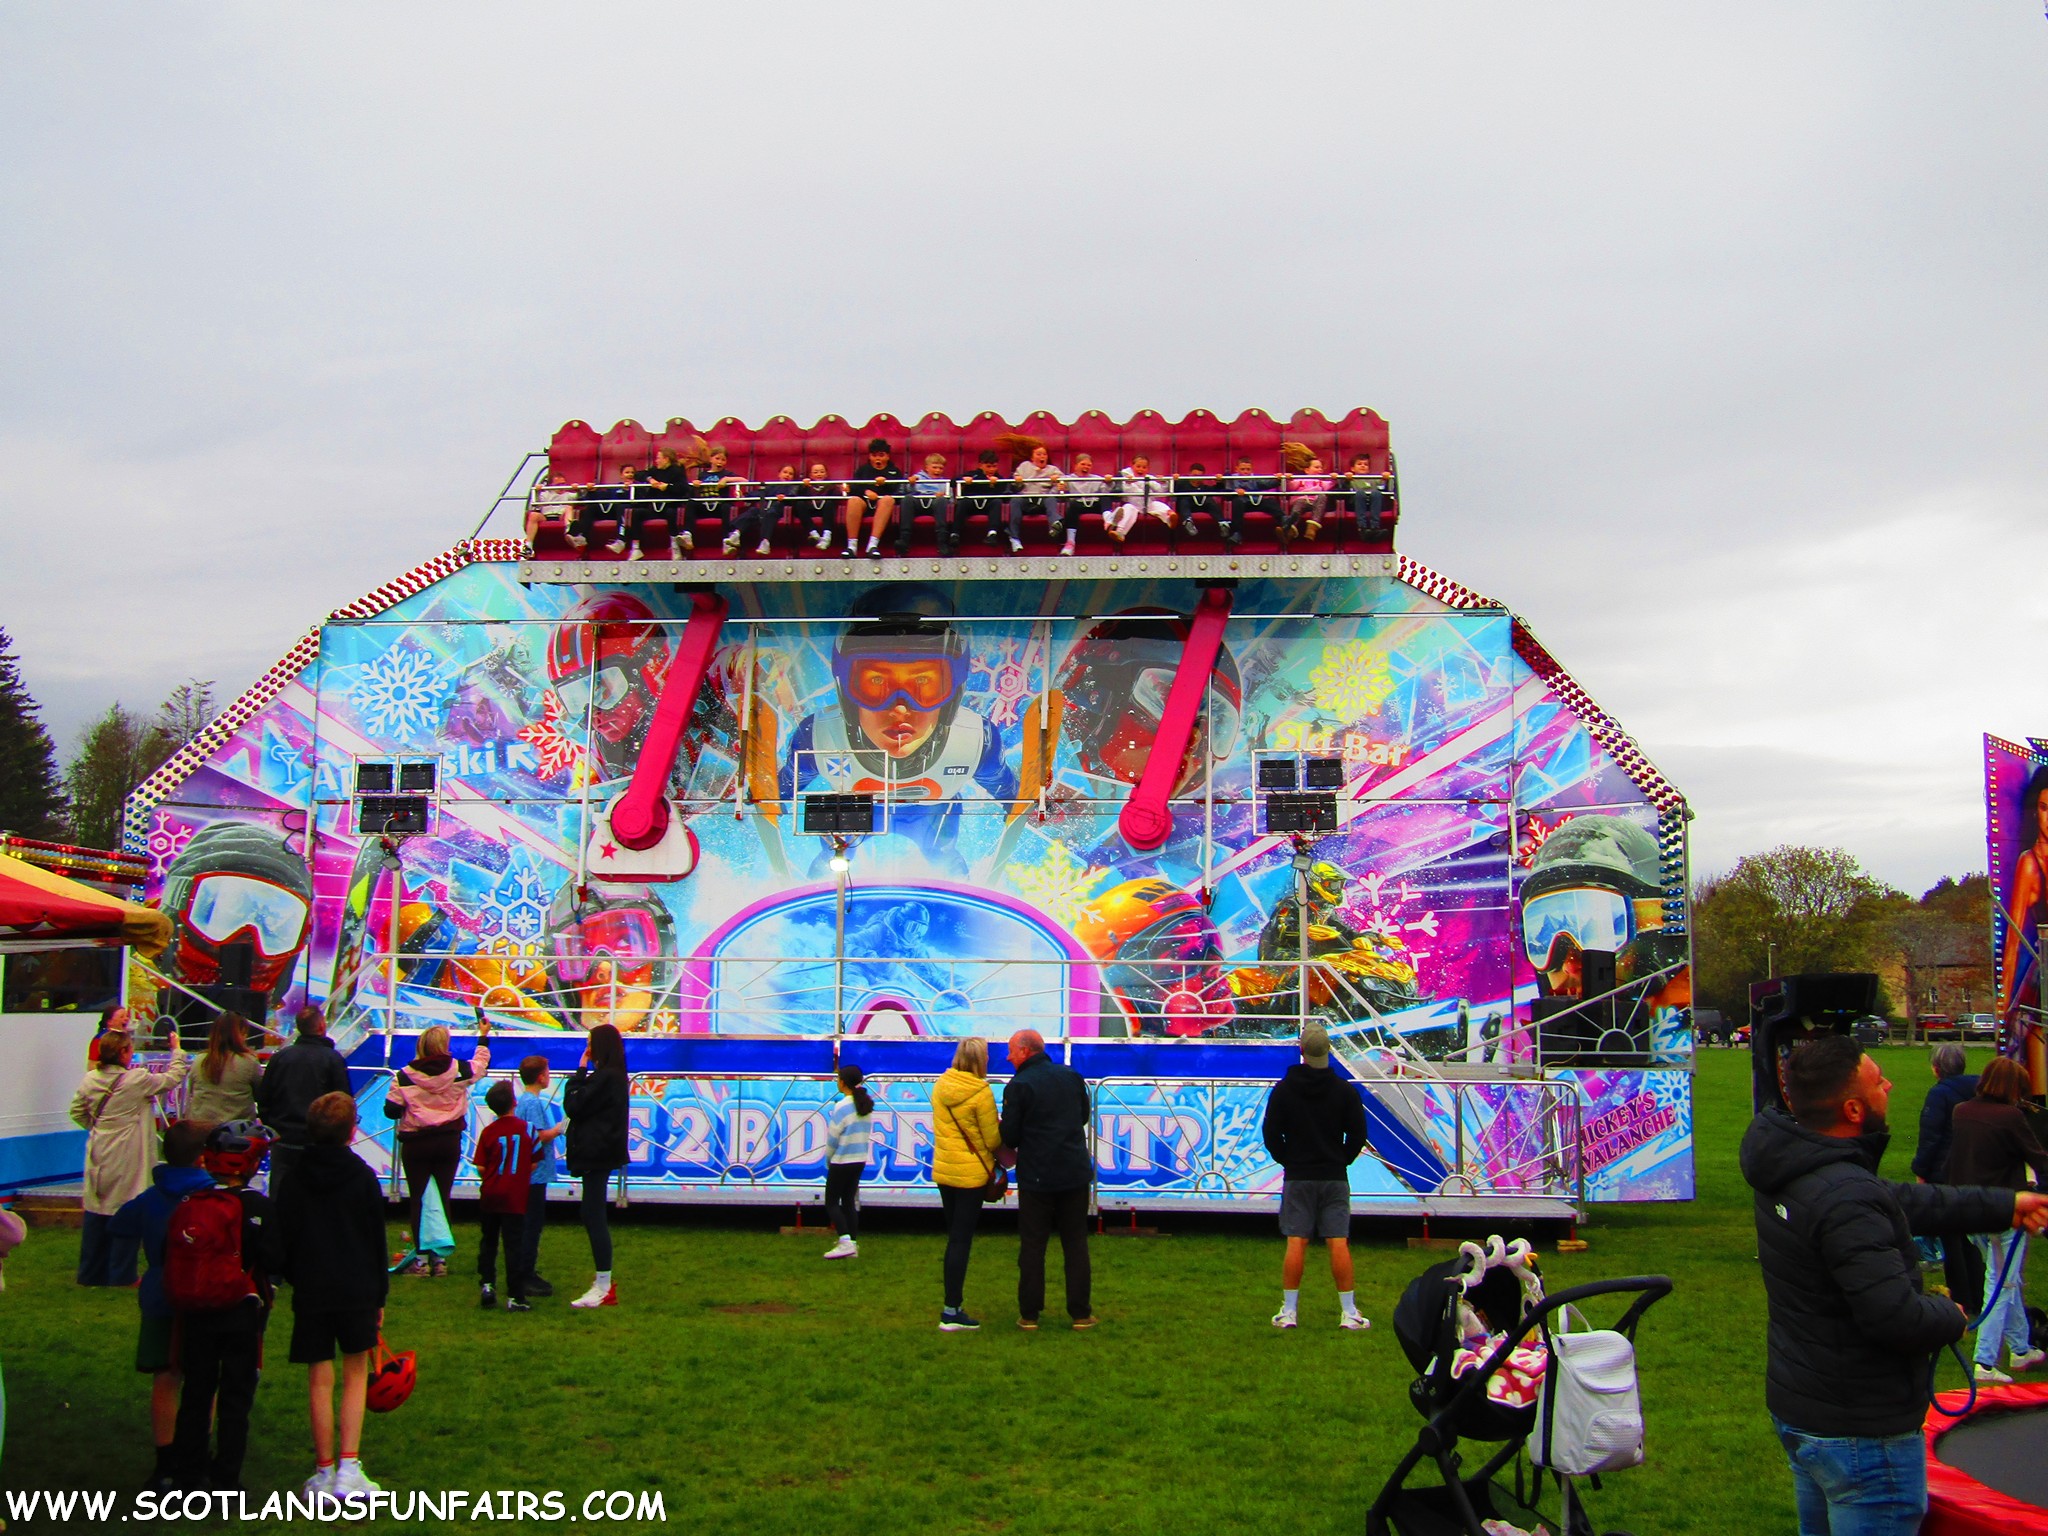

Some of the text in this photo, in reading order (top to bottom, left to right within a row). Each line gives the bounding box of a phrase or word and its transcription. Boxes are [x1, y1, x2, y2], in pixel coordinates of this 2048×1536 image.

[442, 742, 498, 779] ski
[1277, 724, 1409, 767] Ski Bar
[498, 1133, 521, 1175] 11
[1580, 1104, 1677, 1177] VALANCHE
